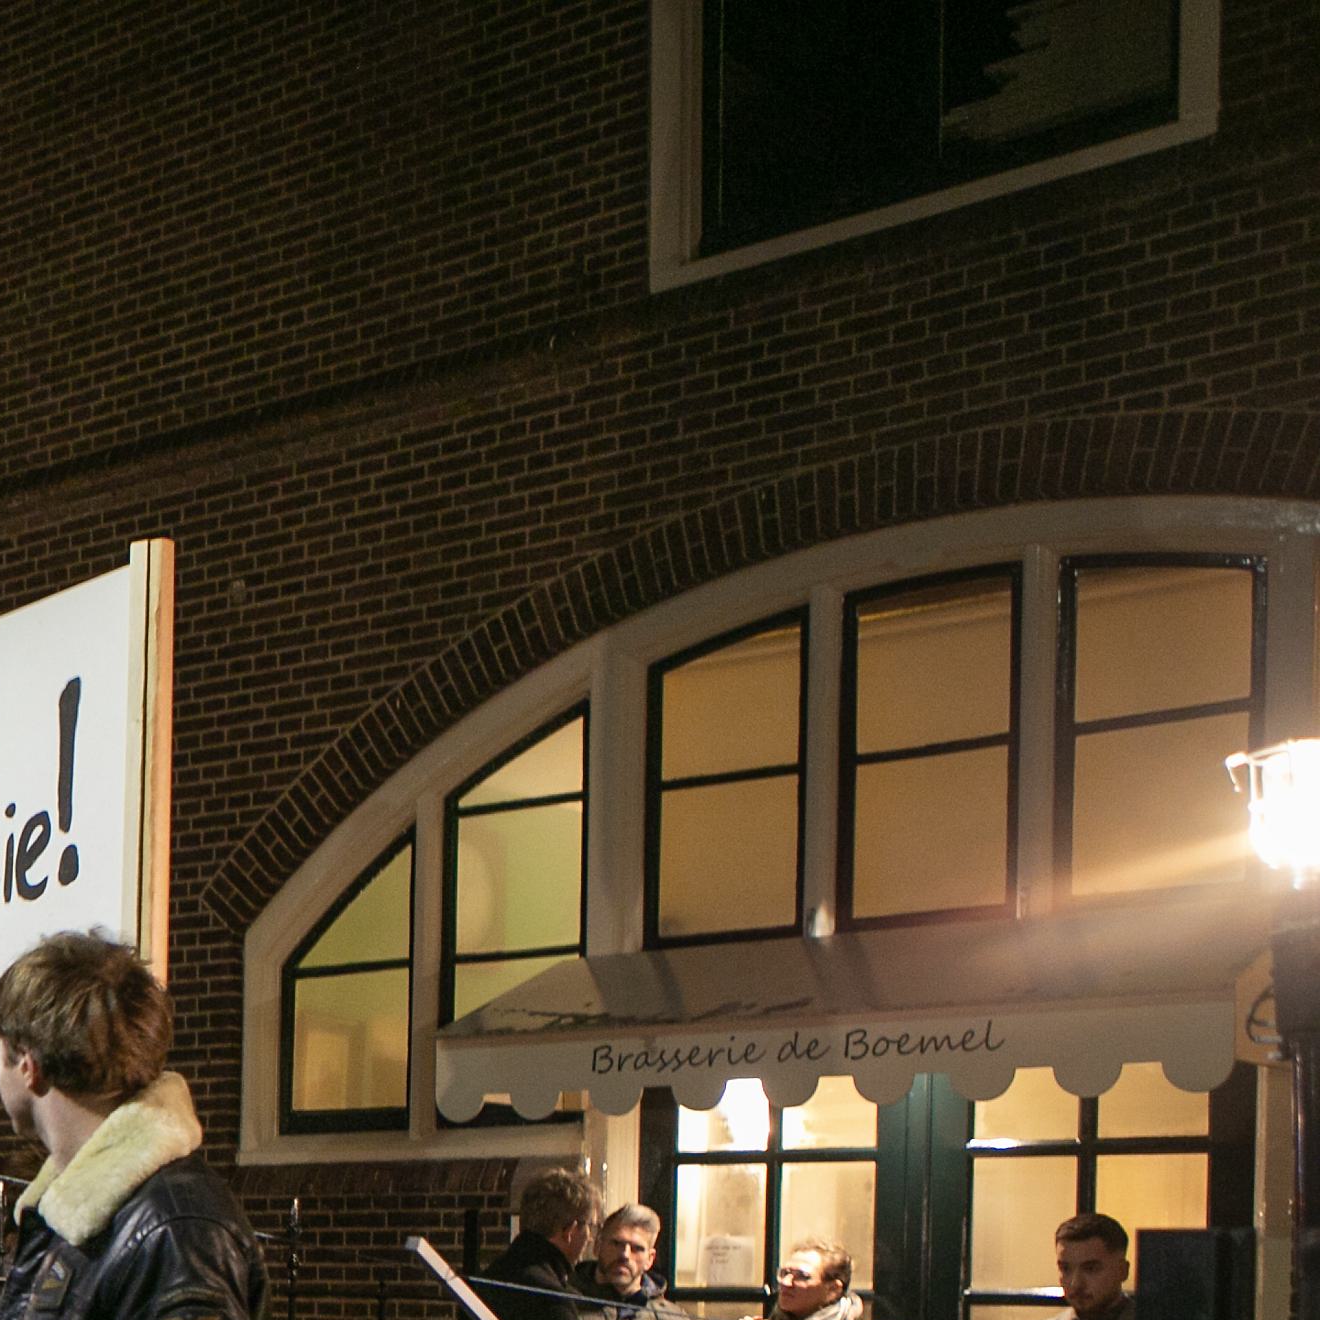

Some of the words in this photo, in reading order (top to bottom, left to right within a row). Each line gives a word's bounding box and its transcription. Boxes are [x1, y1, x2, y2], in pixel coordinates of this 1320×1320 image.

[591, 1035, 766, 1074] Brasserie
[776, 1031, 832, 1061] de
[843, 1020, 1006, 1060] Boemel
